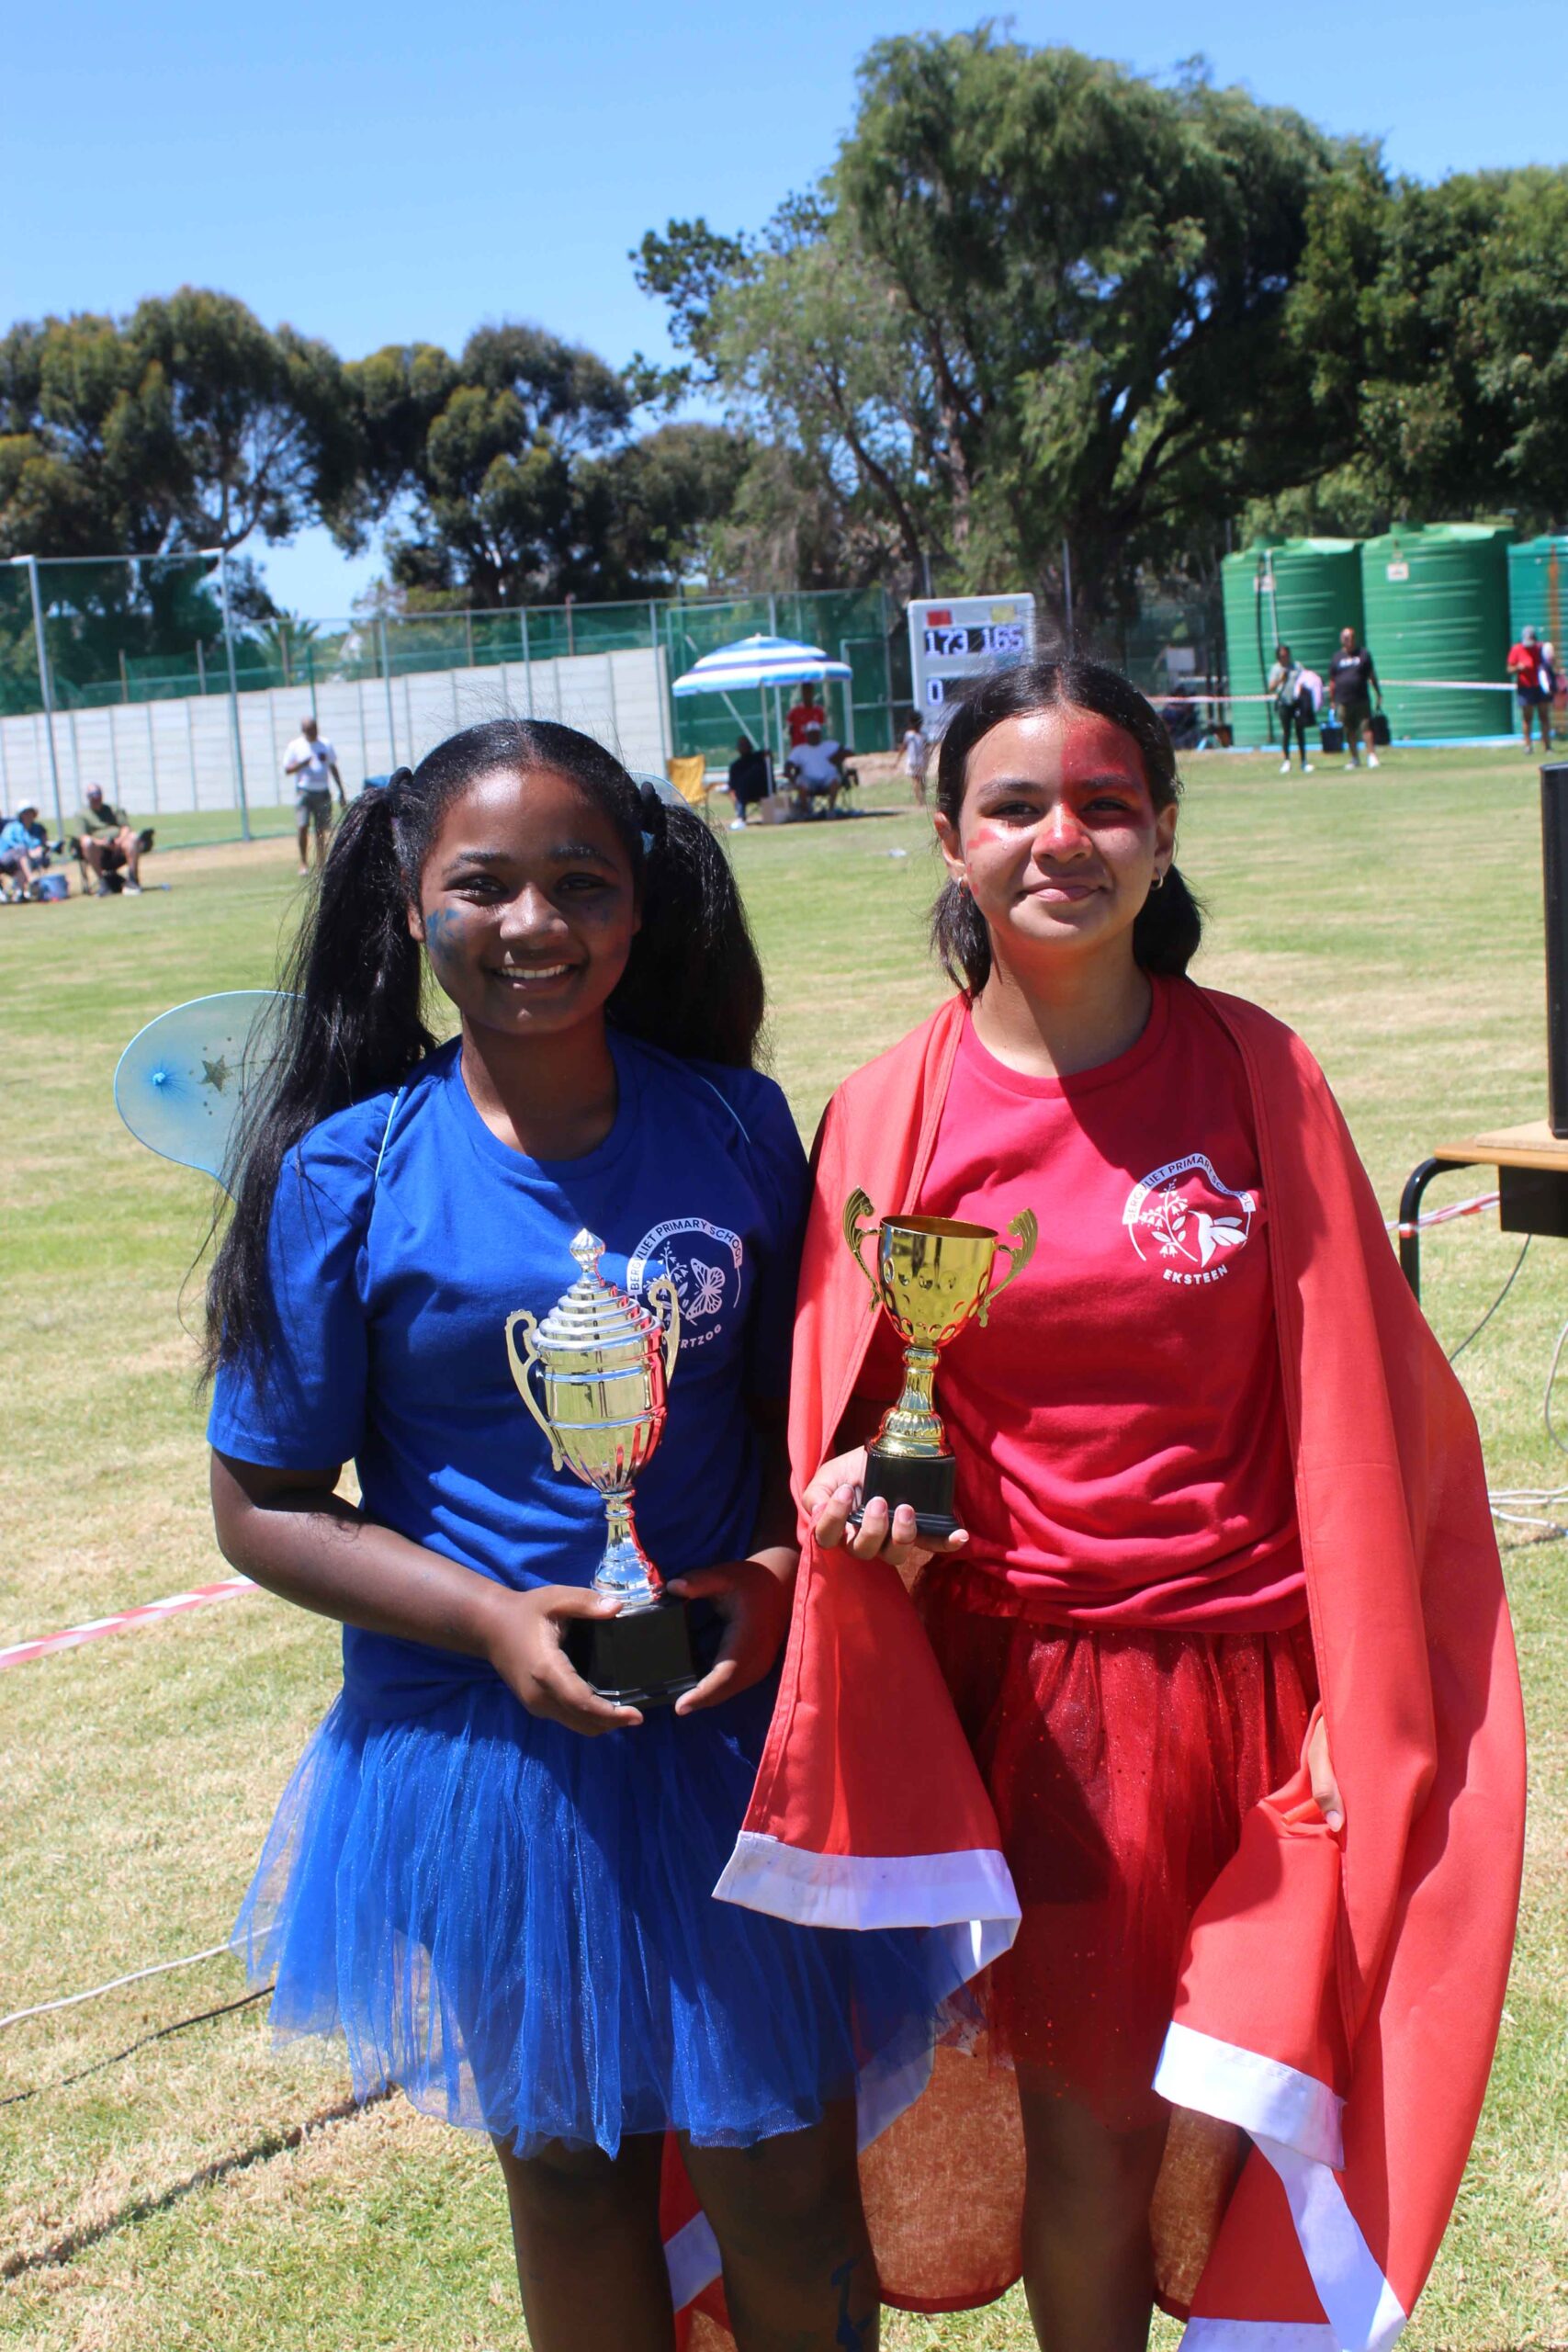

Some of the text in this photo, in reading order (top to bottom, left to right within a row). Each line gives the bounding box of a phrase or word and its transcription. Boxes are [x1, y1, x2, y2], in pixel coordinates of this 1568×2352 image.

[926, 629, 968, 656] 173
[927, 679, 943, 706] 0
[1168, 1156, 1213, 1175] PRIMARY
[630, 1219, 742, 1291] BERGVLIET PRIMARY SCHOOL
[1163, 1264, 1228, 1284] EKSTEEN
